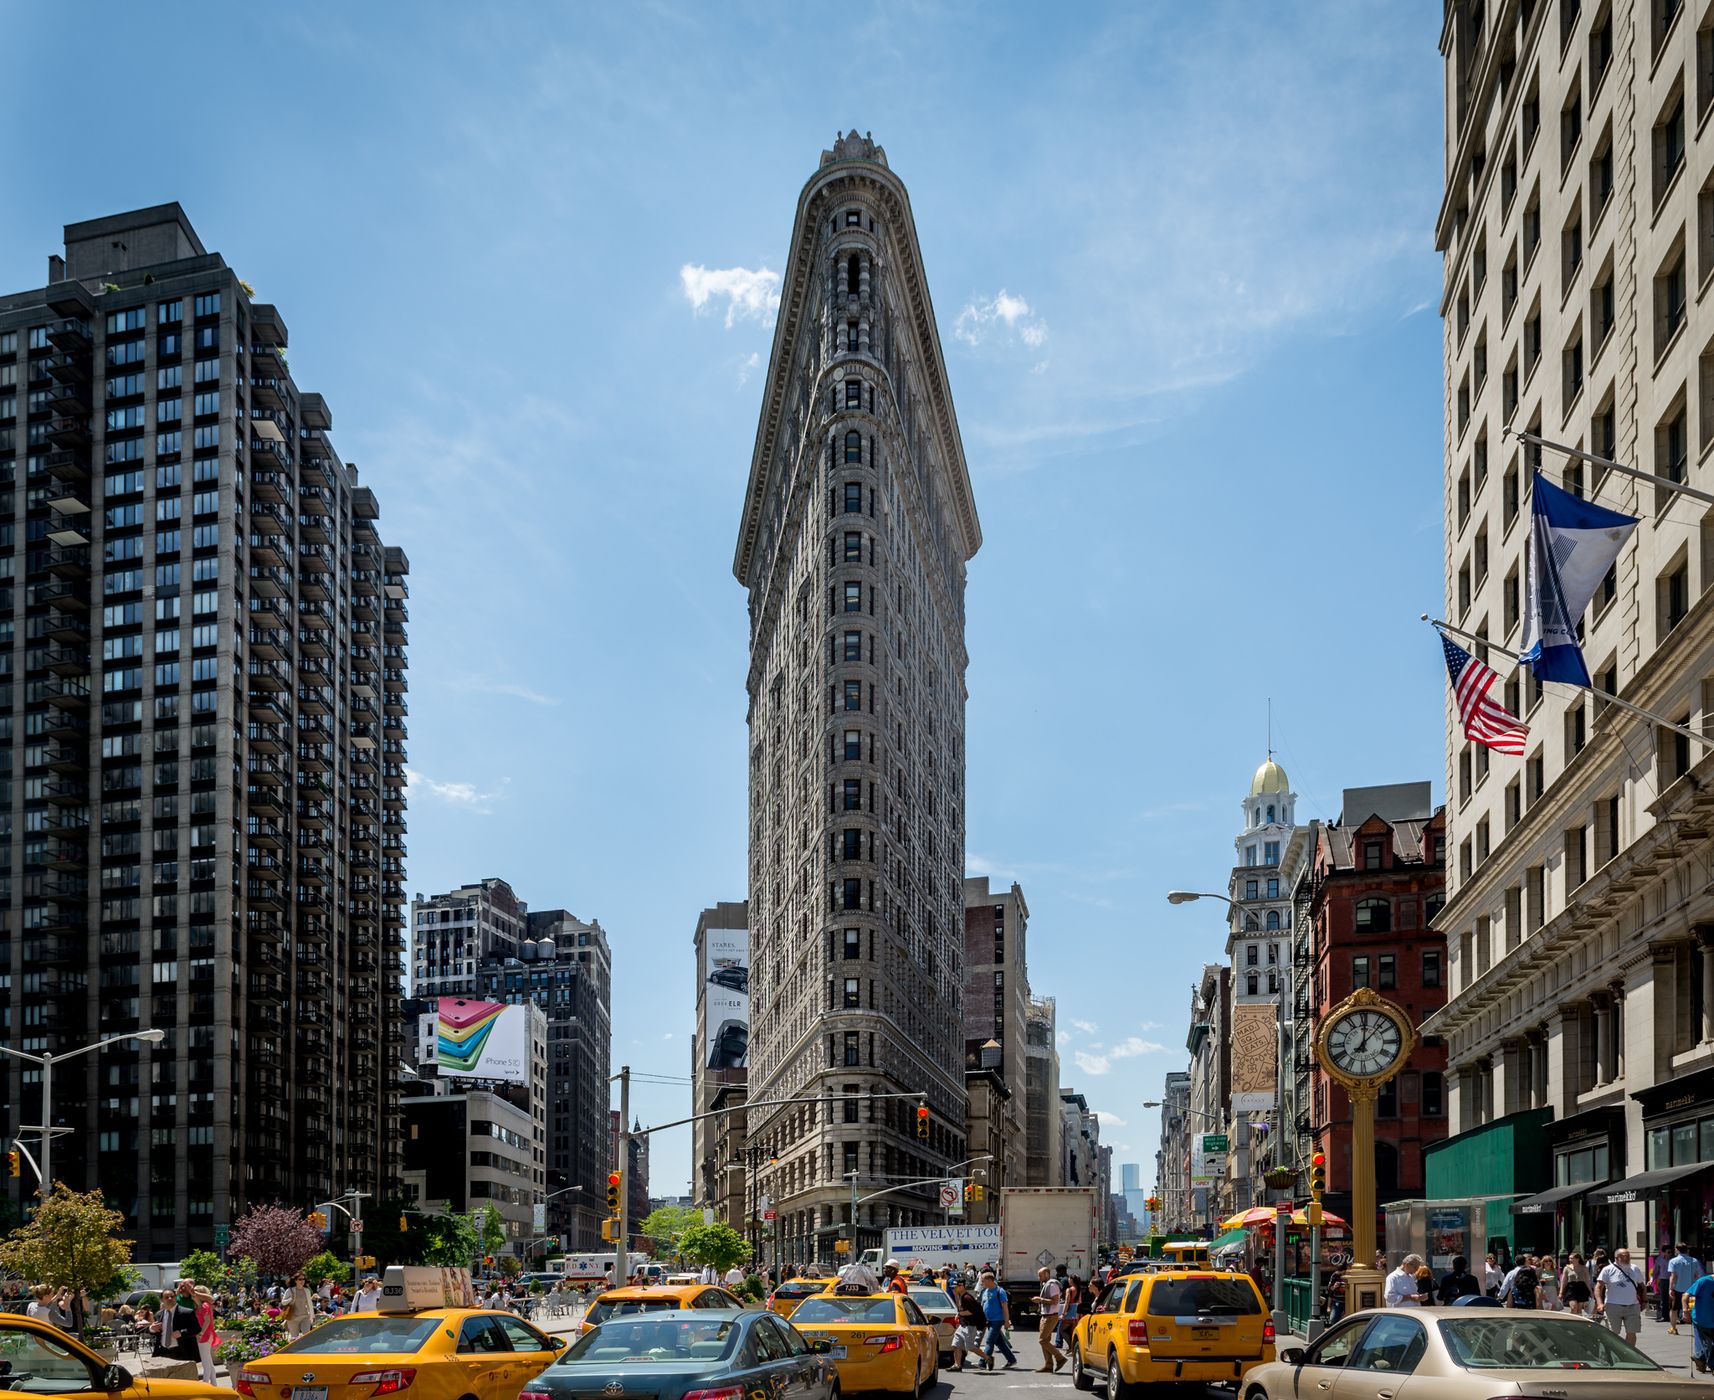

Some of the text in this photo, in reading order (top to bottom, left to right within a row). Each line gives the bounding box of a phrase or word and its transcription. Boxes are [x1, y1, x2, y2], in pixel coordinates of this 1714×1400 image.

[1236, 1025, 1257, 1037] MAD.
[1240, 1036, 1255, 1045] SQ.
[485, 1057, 508, 1066] iPhone
[1665, 1093, 1696, 1110] marimekko
[1607, 1190, 1637, 1203] marimekko
[1522, 1204, 1542, 1213] marimekko
[891, 1227, 999, 1241] THE VELVET TOU
[845, 1284, 860, 1292] 7J33
[851, 1331, 867, 1339] 261
